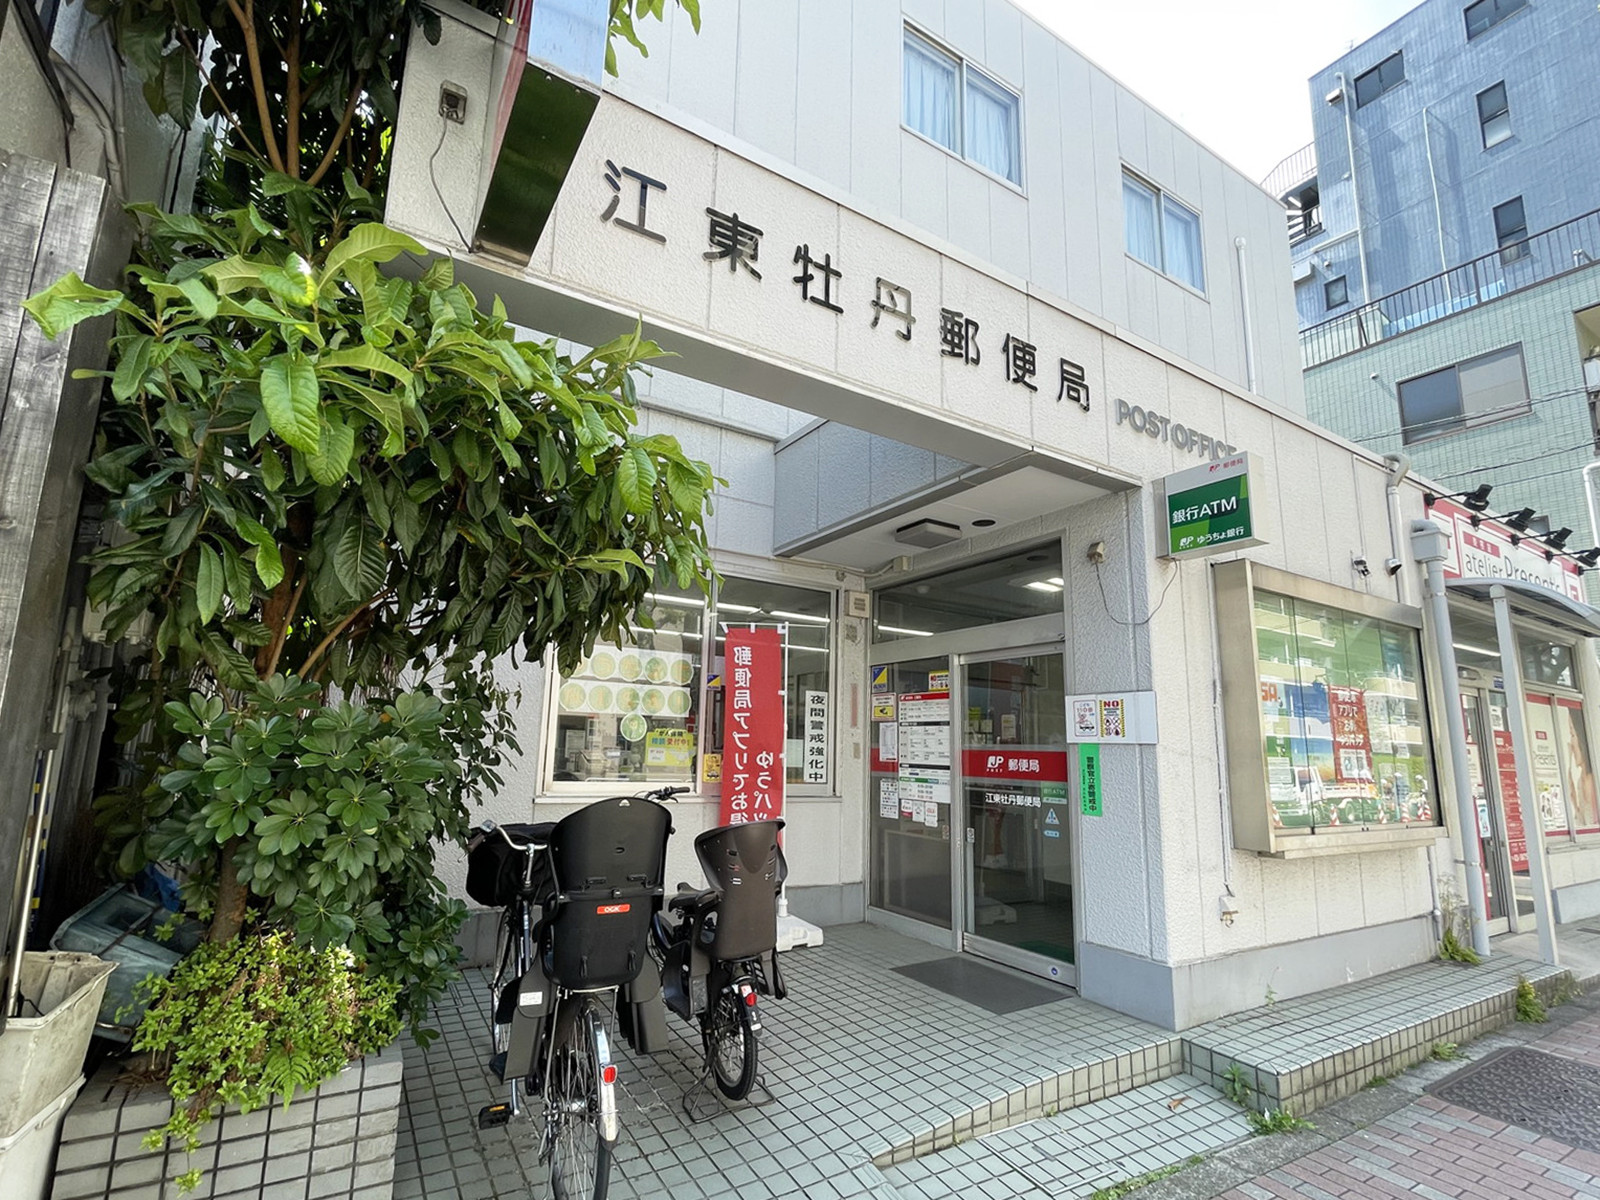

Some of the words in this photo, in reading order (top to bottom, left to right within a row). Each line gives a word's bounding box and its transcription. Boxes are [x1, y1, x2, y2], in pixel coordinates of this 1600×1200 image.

[600, 158, 1091, 413] 江東牡丹郵便局
[1115, 398, 1170, 444] POST
[1172, 495, 1237, 524] 銀行ATM
[1196, 526, 1244, 545] ゆうちょ銀行
[1103, 700, 1120, 708] NO
[808, 694, 826, 782] 夜間警戒強化中
[1007, 758, 1040, 773] 郵便局
